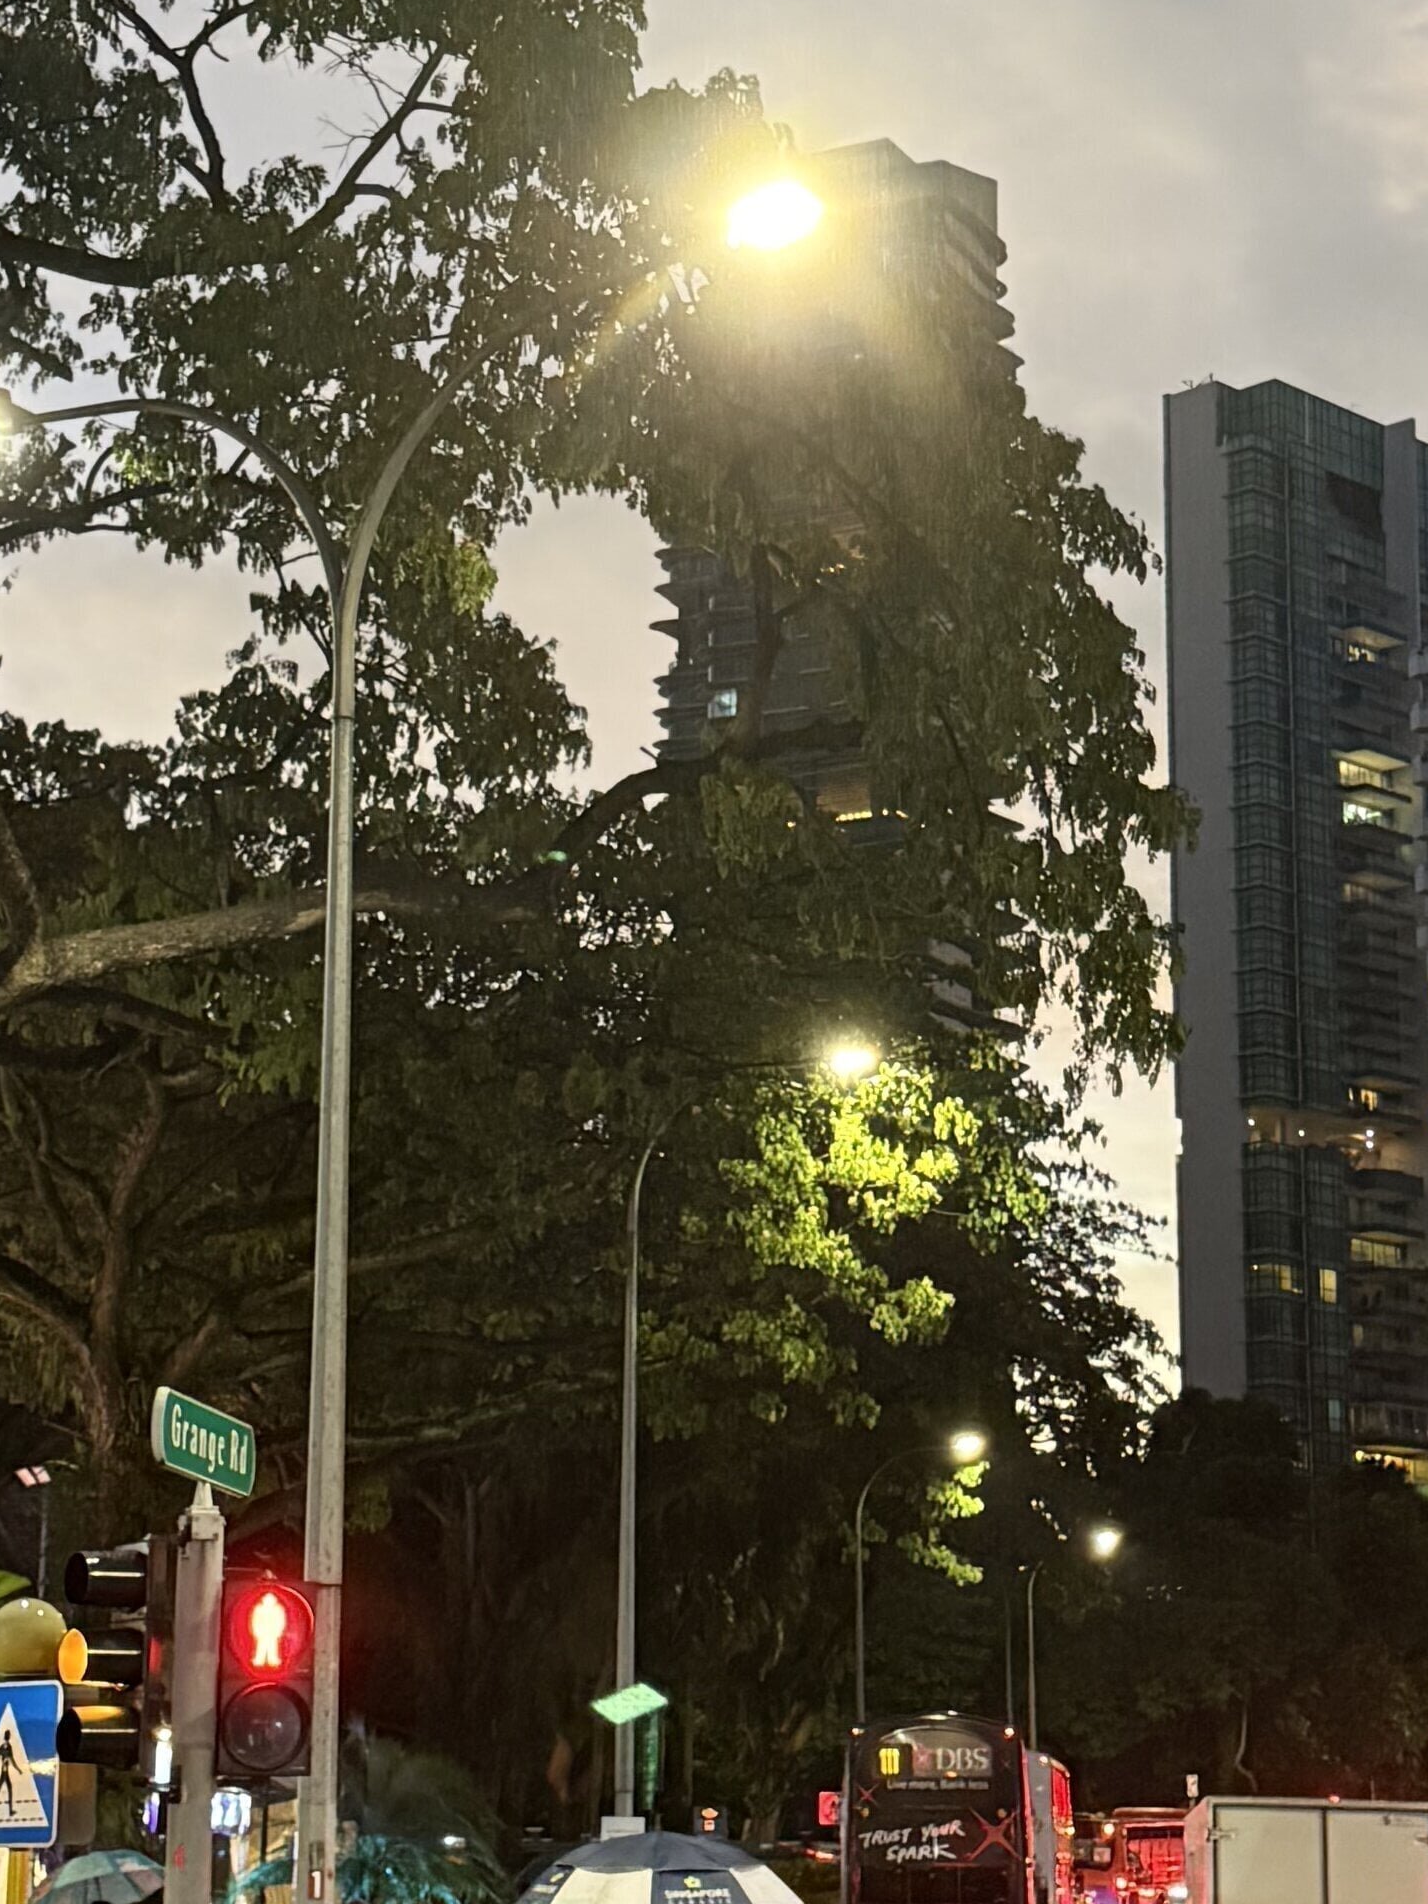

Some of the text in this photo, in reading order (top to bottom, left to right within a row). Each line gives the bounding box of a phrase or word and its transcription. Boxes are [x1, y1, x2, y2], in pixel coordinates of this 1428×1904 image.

[171, 1403, 248, 1475] Grange Rd
[935, 1747, 989, 1771] DBS
[858, 1819, 967, 1848] TRUST YOUR
[886, 1838, 957, 1864] SPARK
